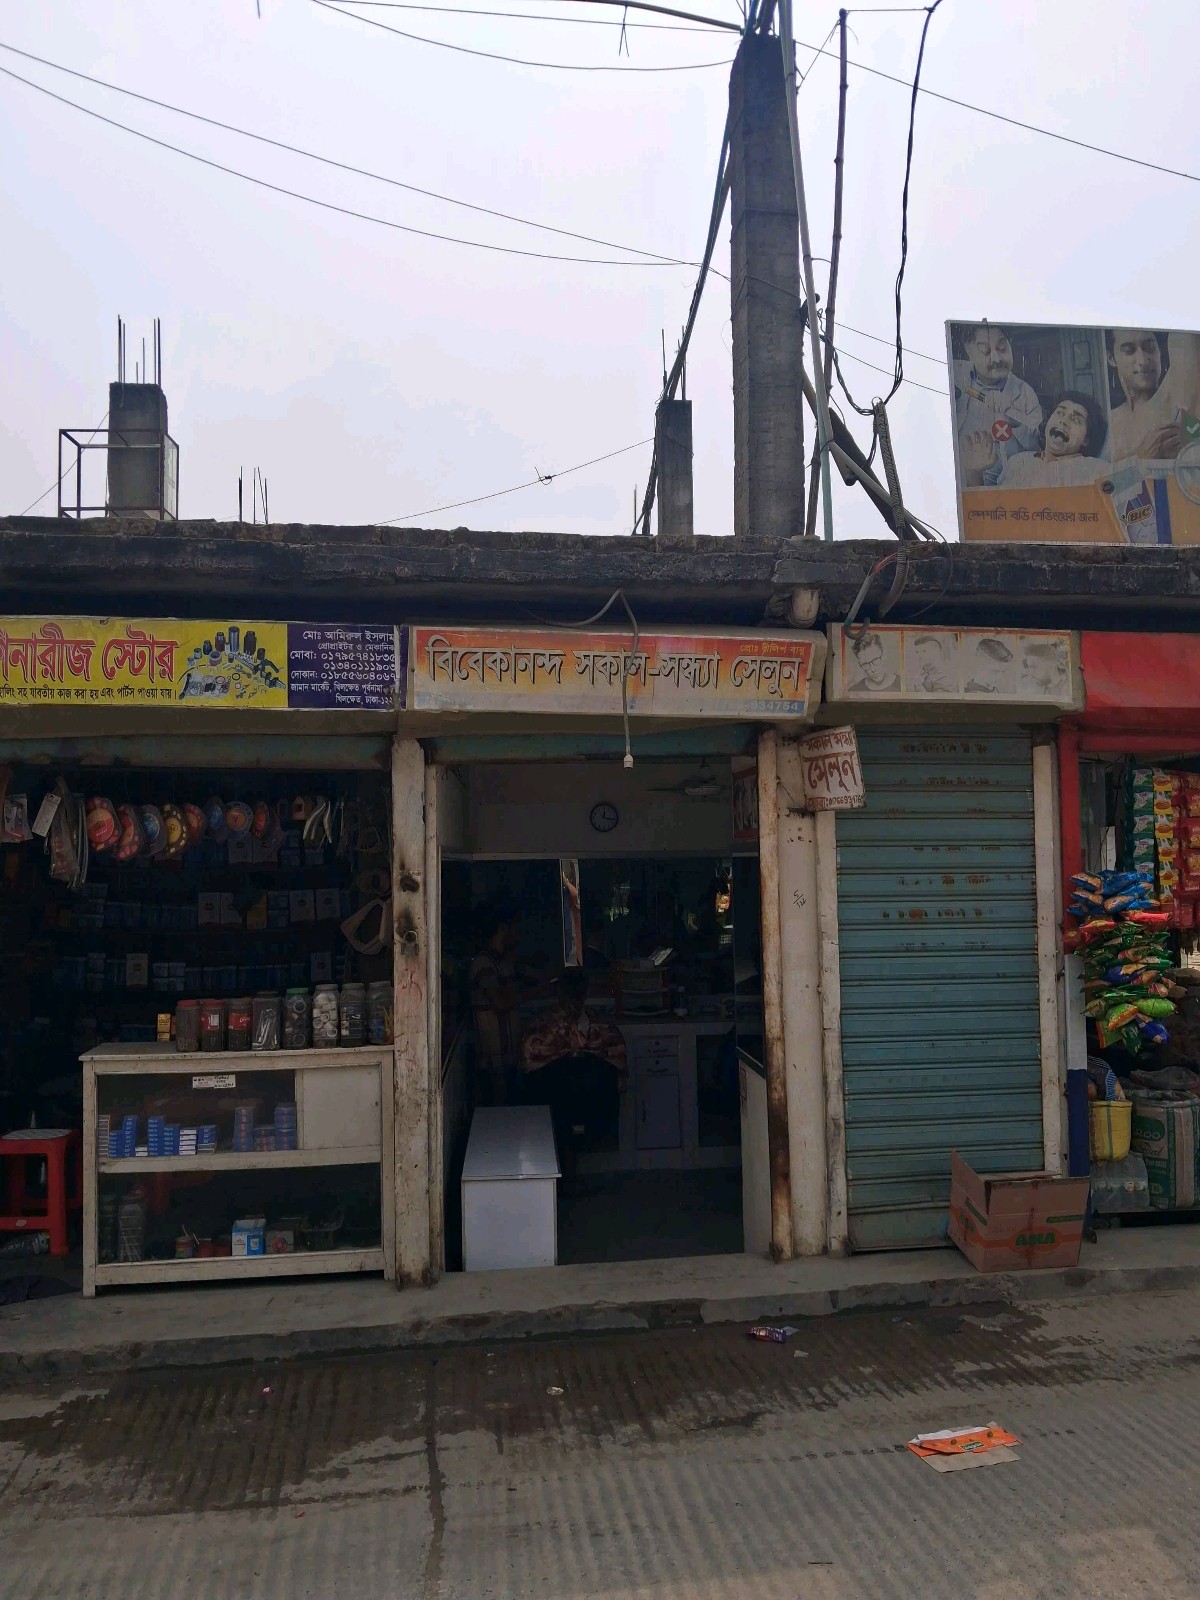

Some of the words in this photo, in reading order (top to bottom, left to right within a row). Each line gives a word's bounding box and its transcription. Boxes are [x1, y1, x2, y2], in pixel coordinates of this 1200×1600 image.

[967, 506, 1006, 521] স্পেশালি
[1010, 507, 1029, 521] বডি
[1078, 512, 1099, 522] জন্য
[1130, 507, 1150, 521] BIC
[324, 629, 362, 642] আমিরুল
[364, 630, 395, 643] ইসলাম
[102, 624, 180, 684] স্টোর
[425, 634, 566, 685] বিবেকানন্দ
[731, 655, 804, 698] সেলুন
[17, 687, 28, 699] সহ
[30, 684, 54, 700] যাবতীয়
[57, 688, 72, 699] কাজ
[74, 688, 87, 700] করা
[89, 689, 99, 700] হয়
[100, 687, 114, 700] এবং
[137, 687, 157, 700] পাওয়া
[290, 683, 309, 692] জামান
[365, 695, 393, 705] ঢাকা-১২২
[802, 751, 858, 794] সেলুন
